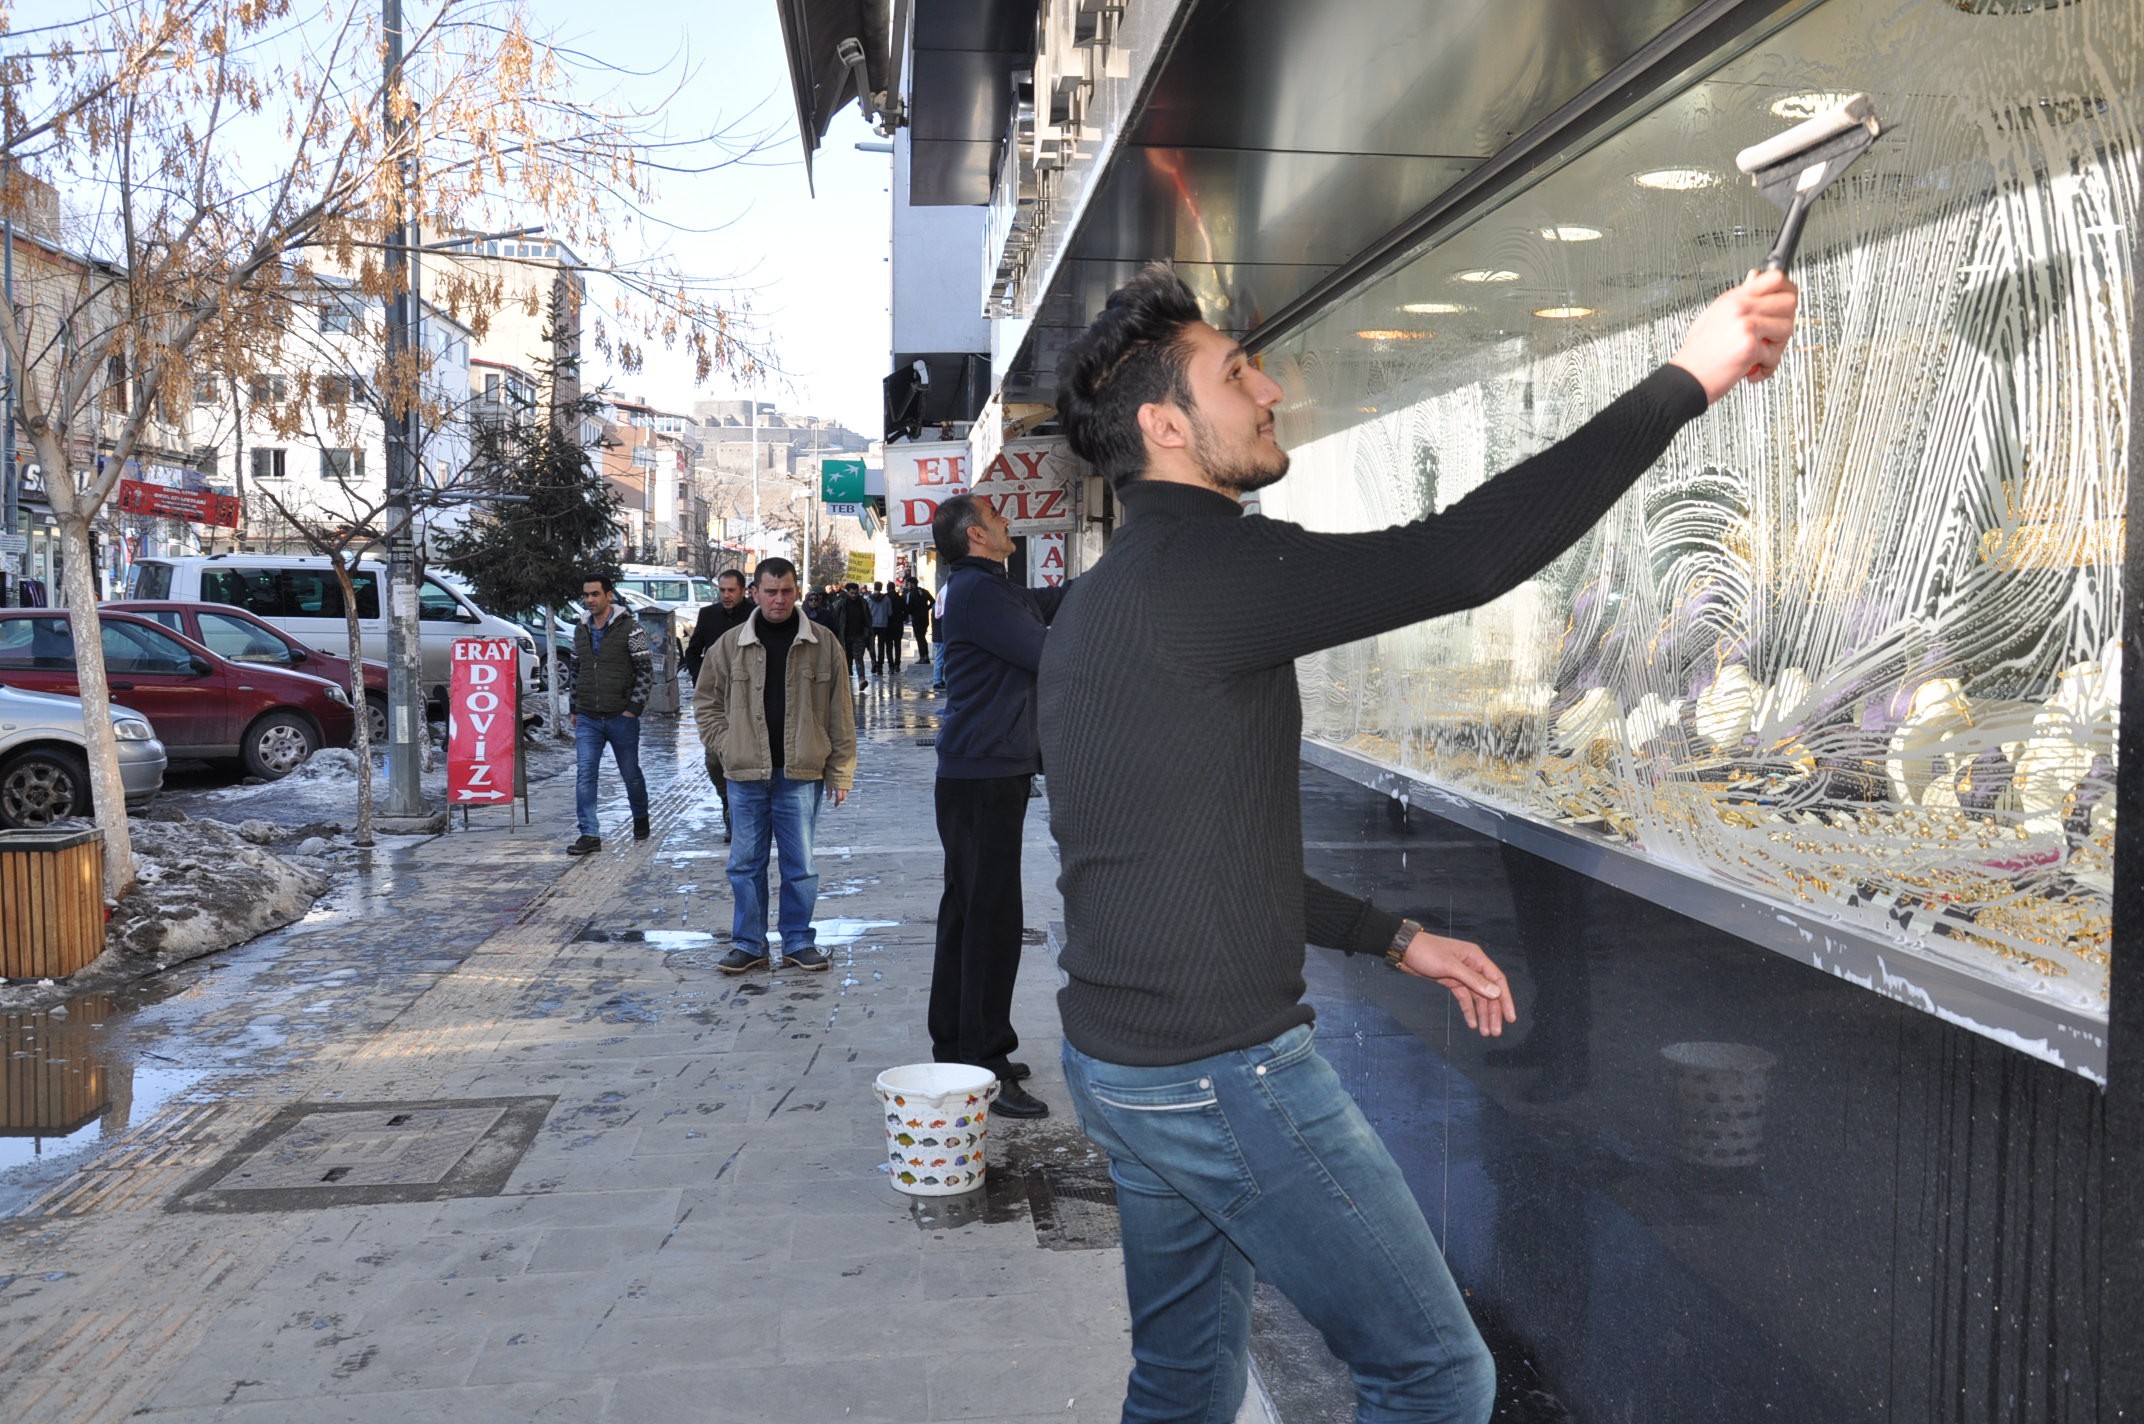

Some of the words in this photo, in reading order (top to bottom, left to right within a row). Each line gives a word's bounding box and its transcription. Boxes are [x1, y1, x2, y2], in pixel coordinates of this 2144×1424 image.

[831, 504, 855, 513] TEB
[900, 484, 1067, 527] DVİZ
[454, 643, 513, 661] ERAY
[466, 664, 499, 786] DÖVİZ
